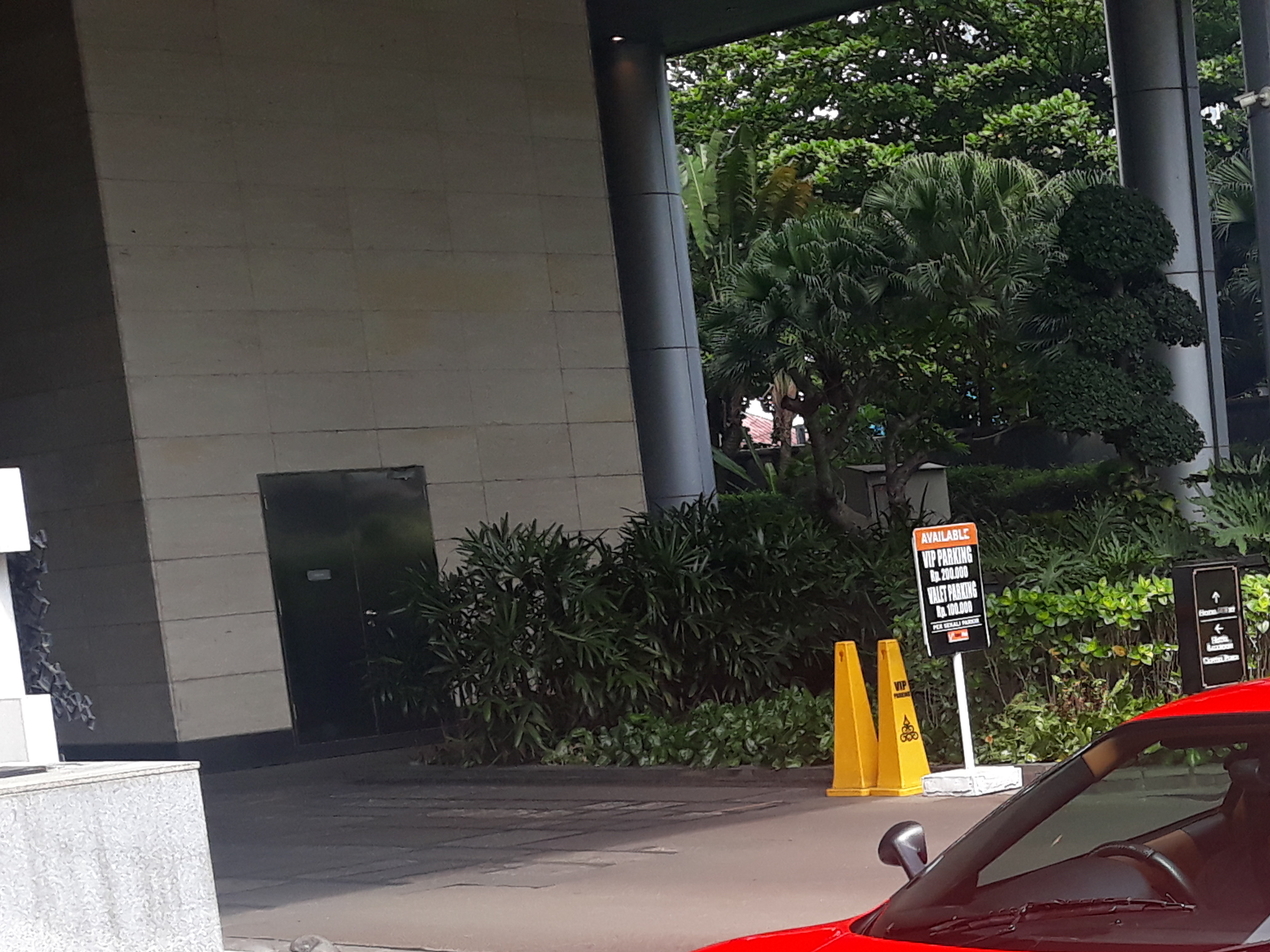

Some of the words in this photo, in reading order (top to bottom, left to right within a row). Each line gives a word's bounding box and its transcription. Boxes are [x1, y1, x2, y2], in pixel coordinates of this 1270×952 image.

[921, 528, 970, 544] AVAILABLE
[922, 550, 936, 568] VIP
[937, 546, 973, 567] PARKING
[941, 565, 969, 581] 200.000
[927, 585, 947, 605] VALET
[947, 580, 978, 601] PARKING
[947, 600, 973, 616] 100.000
[894, 680, 907, 692] VIP
